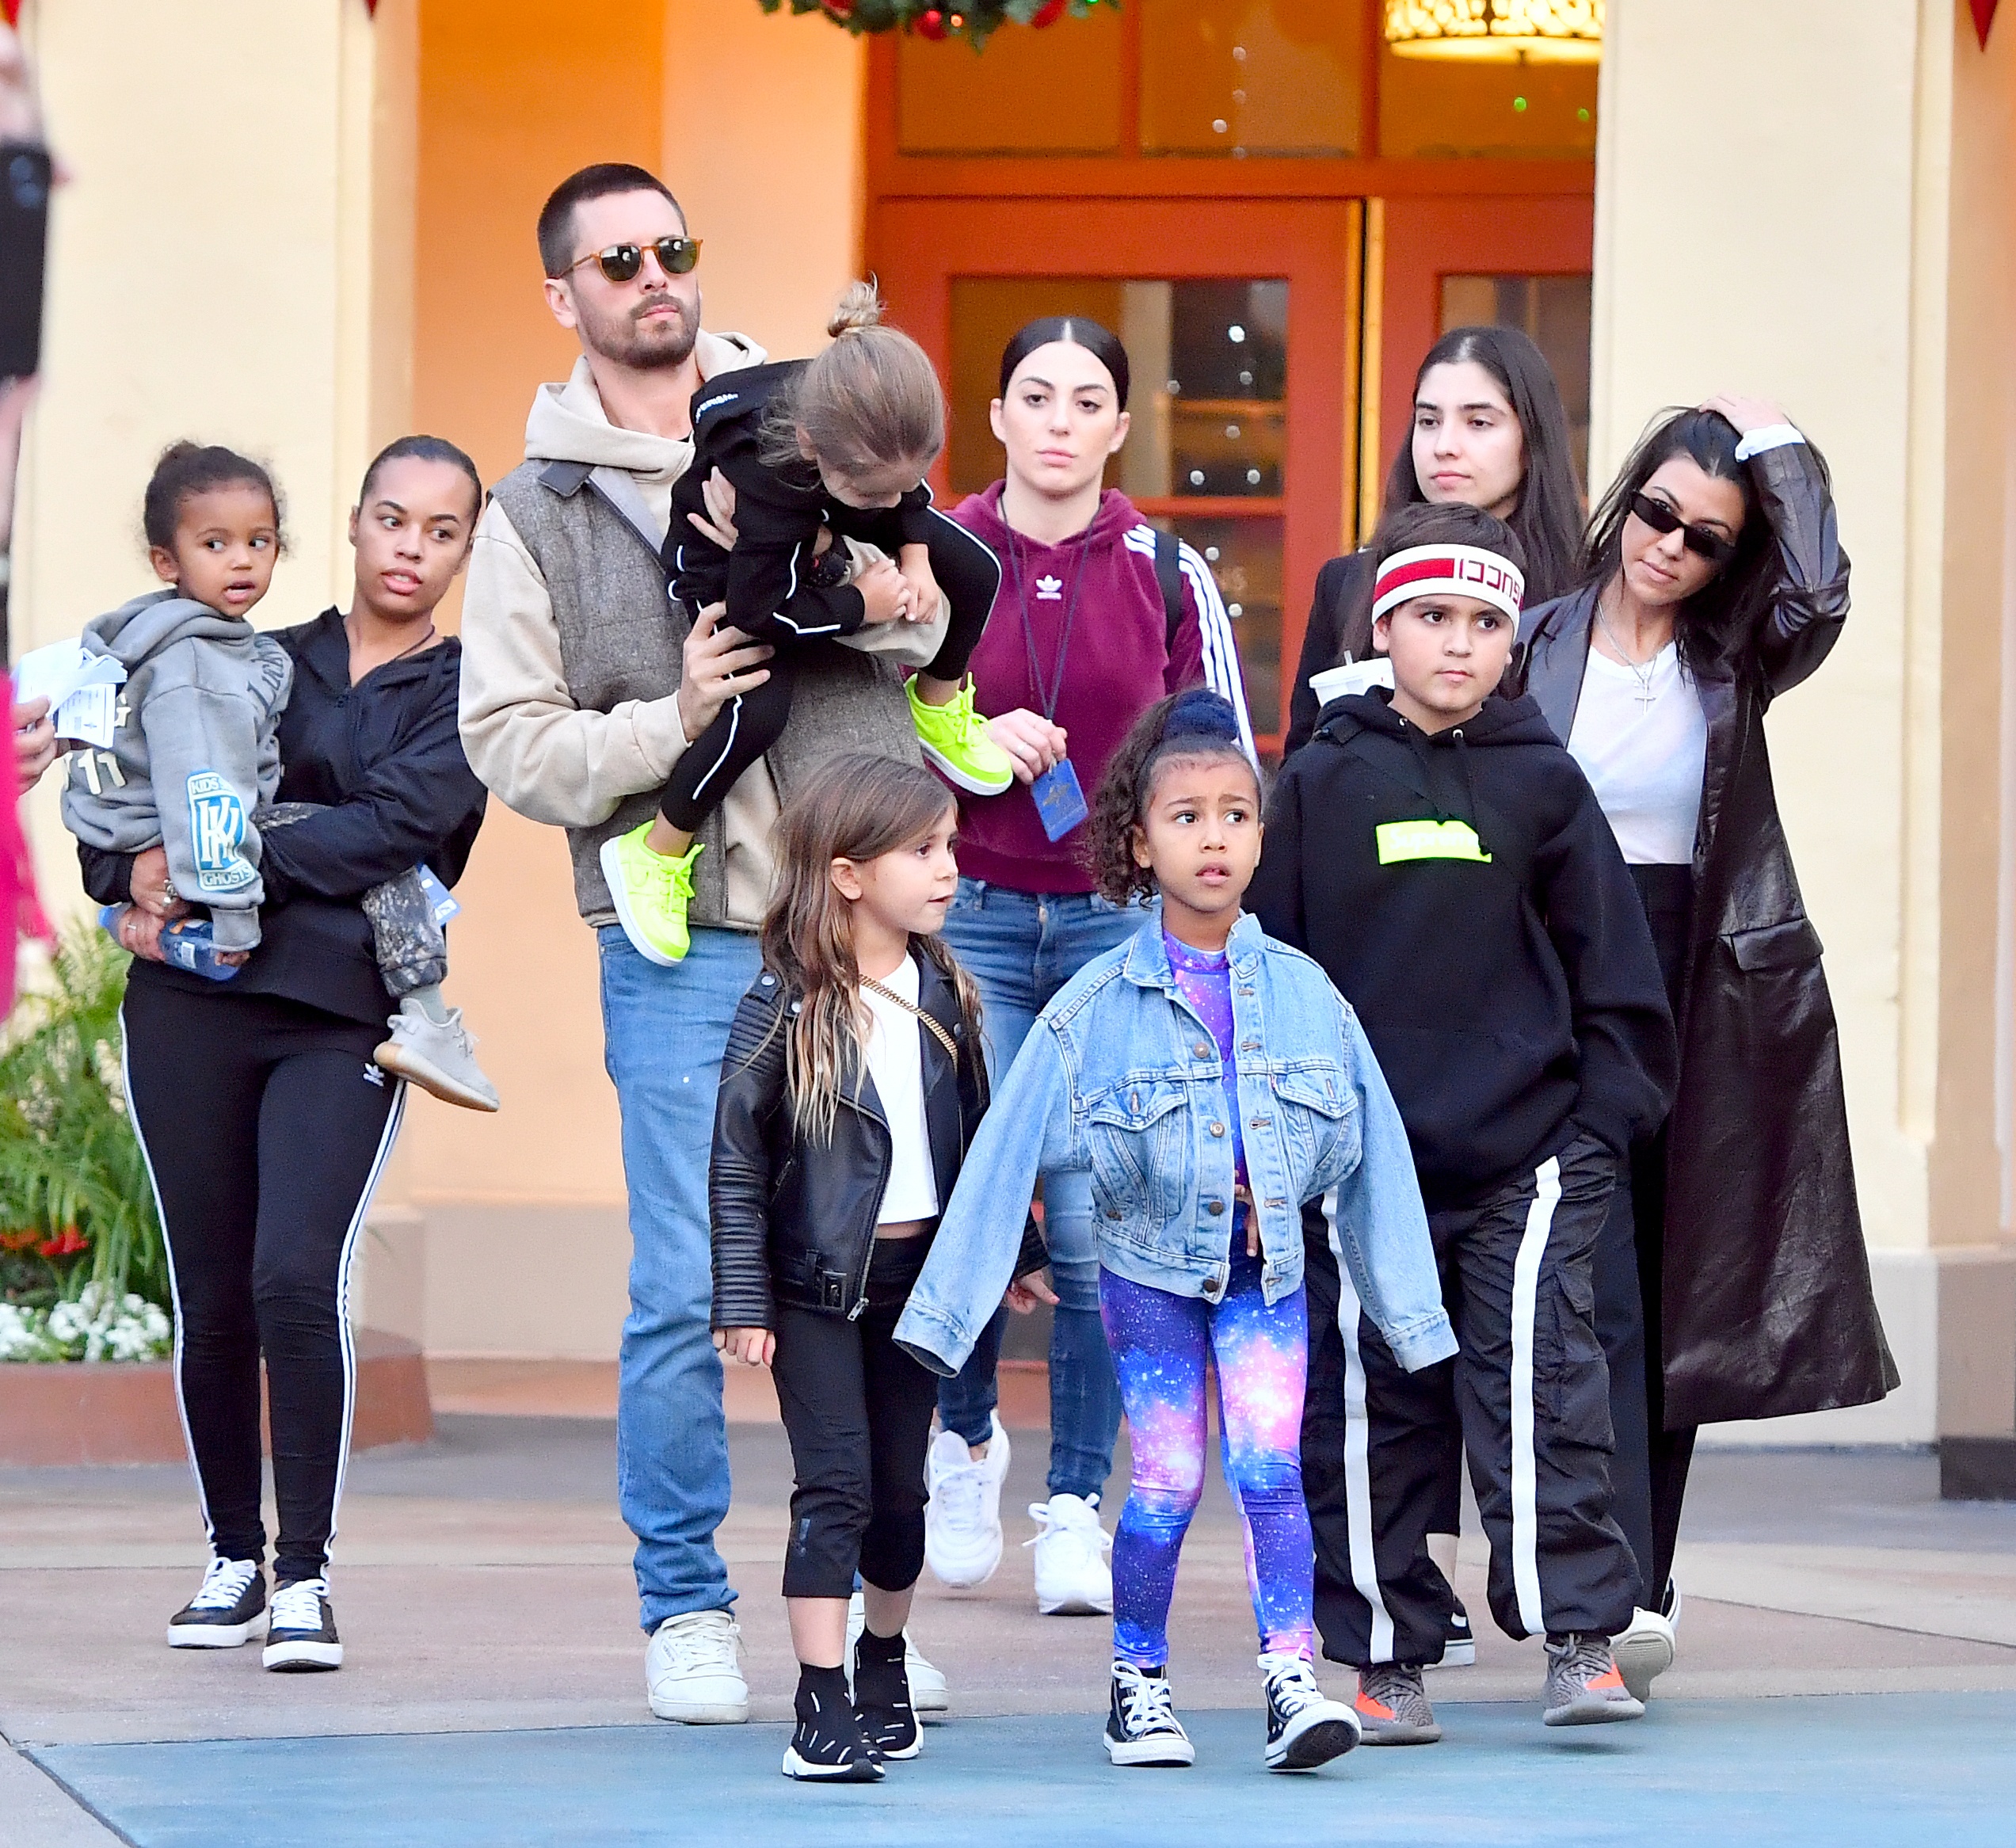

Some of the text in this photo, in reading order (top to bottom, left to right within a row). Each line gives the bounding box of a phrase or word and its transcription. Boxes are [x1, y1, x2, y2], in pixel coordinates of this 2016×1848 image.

[1459, 558, 1521, 605] GUCCI
[191, 777, 219, 794] KIDS
[202, 864, 252, 886] GHOSTS
